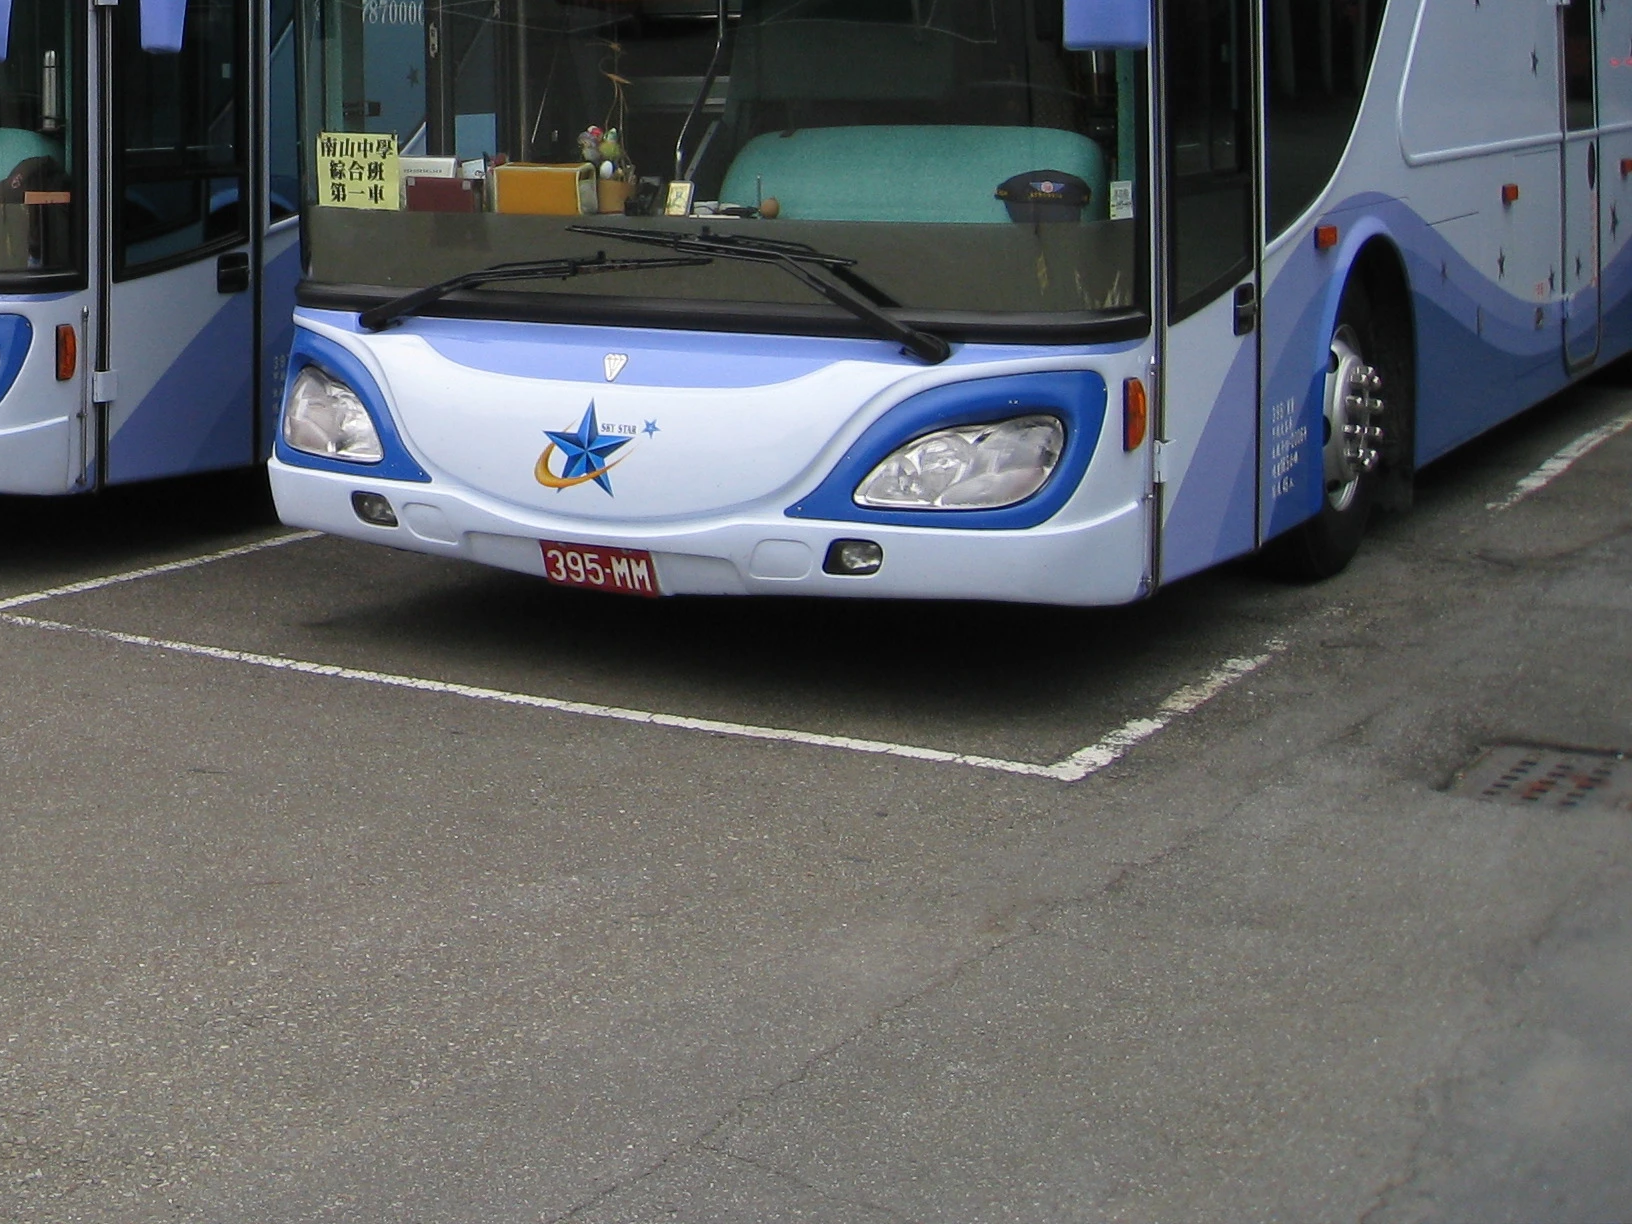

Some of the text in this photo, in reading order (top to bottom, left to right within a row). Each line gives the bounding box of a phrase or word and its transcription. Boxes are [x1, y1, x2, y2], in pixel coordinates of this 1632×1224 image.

[320, 136, 394, 159] 南山中學
[329, 160, 385, 182] 綜合班
[331, 182, 385, 204] 第一車
[618, 423, 637, 434] STAR
[546, 549, 653, 592] 395-MM
